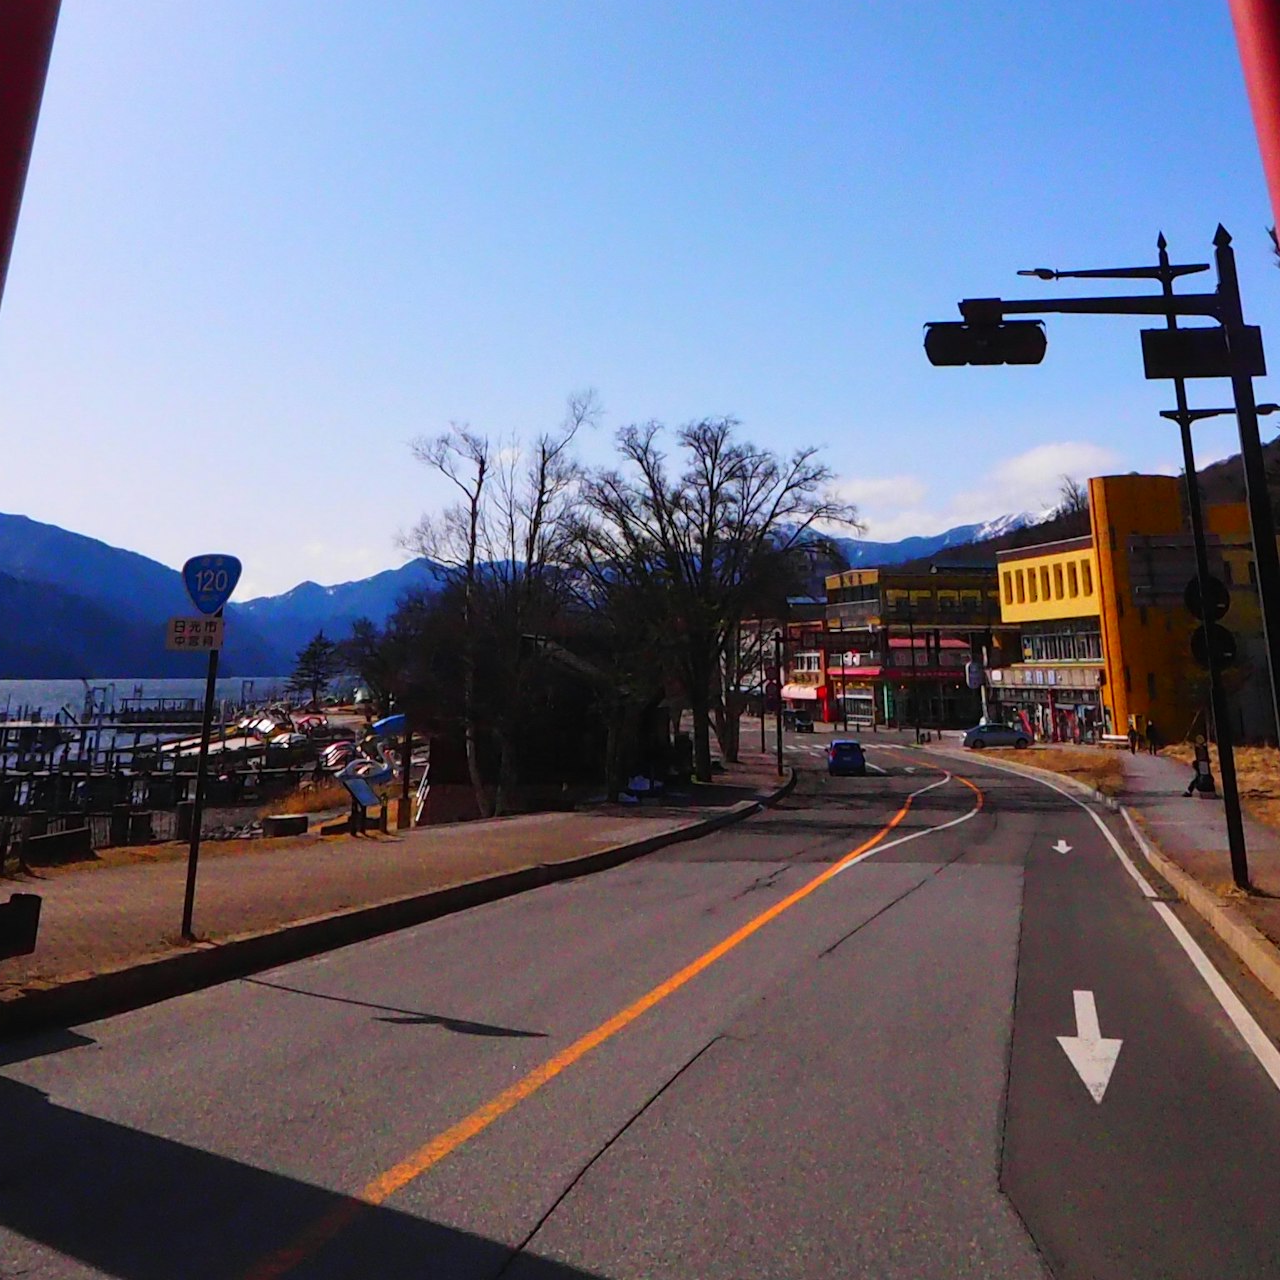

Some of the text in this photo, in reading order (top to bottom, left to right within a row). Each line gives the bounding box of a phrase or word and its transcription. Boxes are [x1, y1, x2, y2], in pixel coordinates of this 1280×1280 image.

[195, 569, 229, 593] 120
[174, 620, 218, 634] 日光市
